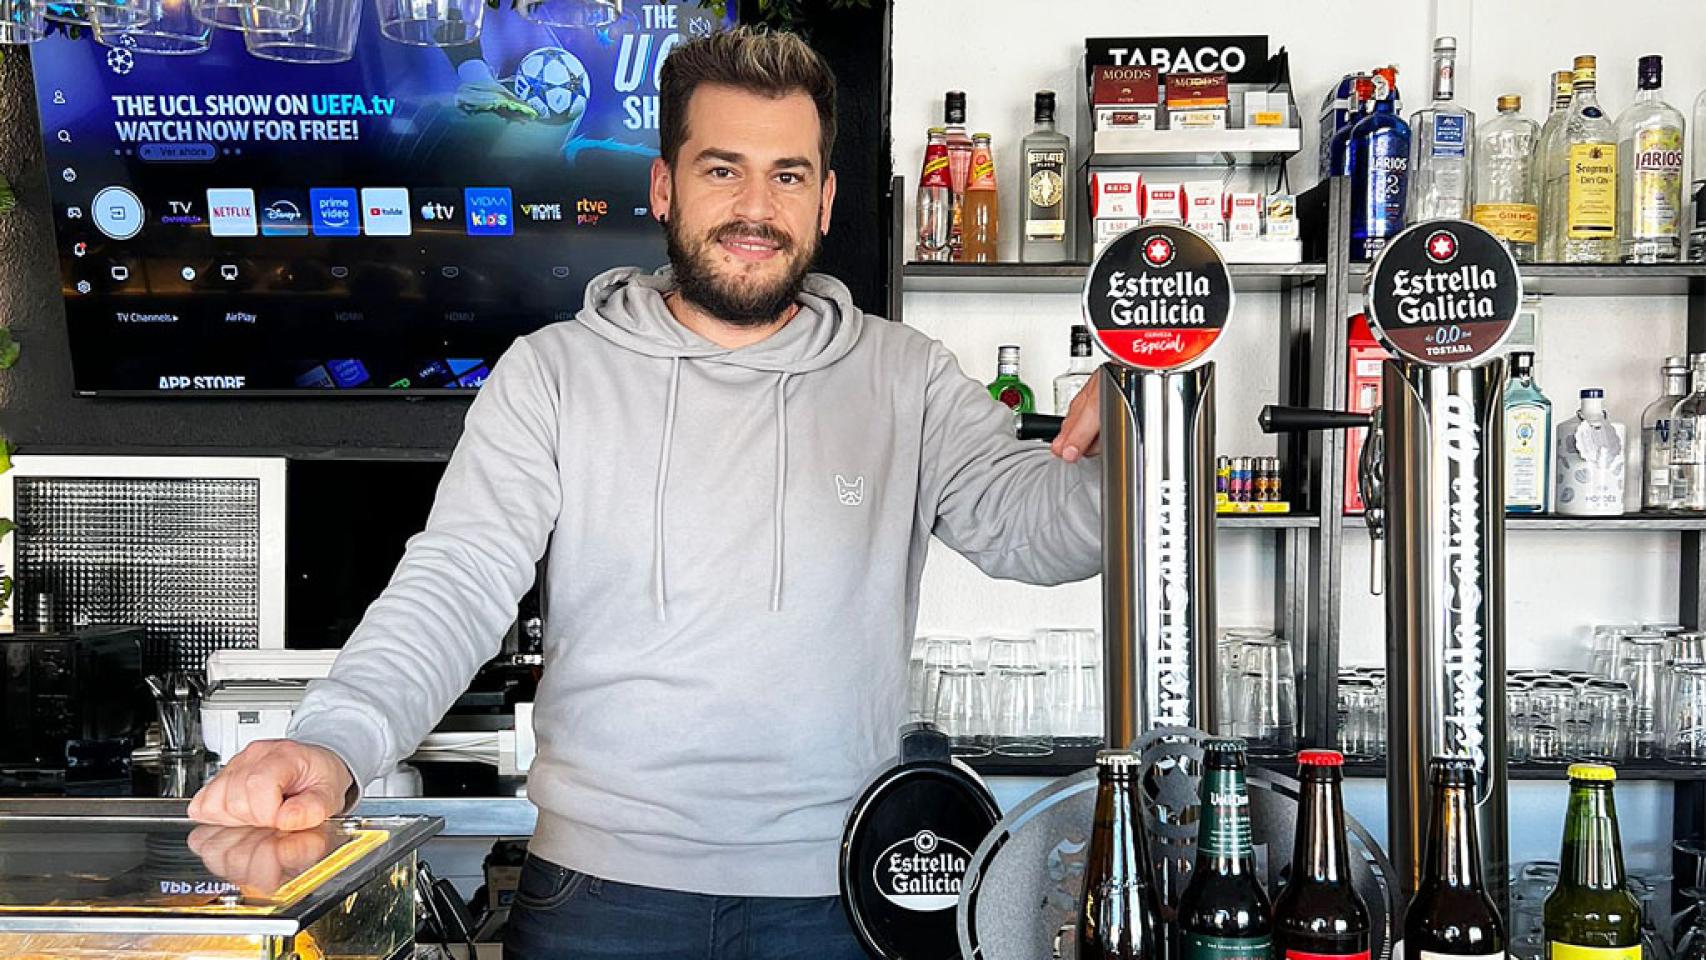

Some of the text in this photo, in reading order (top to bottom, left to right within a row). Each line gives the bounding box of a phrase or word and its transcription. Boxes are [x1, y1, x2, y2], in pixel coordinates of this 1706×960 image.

[642, 5, 678, 29] THE
[614, 34, 679, 92] UC
[1109, 47, 1246, 73] TABACO
[1103, 69, 1151, 80] MOODS
[112, 95, 396, 116] THE UCL SHOW ON UEFA.tv
[623, 97, 661, 130] SH
[115, 121, 359, 141] WATCH NOW FOR FREE!
[1634, 151, 1683, 170] LARIOS
[168, 201, 193, 214] TV
[212, 206, 251, 217] NETFLIX
[319, 198, 349, 208] prime
[434, 202, 454, 220] tv
[576, 198, 608, 215] rtve
[320, 208, 349, 219] video
[471, 210, 508, 226] kids
[577, 214, 599, 226] play
[1106, 271, 1211, 298] Estrella
[1392, 264, 1498, 296] Estrella
[116, 312, 172, 322] TV Channels
[1110, 297, 1206, 326] Galicia
[1397, 291, 1495, 324] Galicia
[225, 312, 257, 324] AirPlay
[1132, 334, 1185, 354] Especial
[1425, 344, 1474, 356] TOSTADA
[159, 376, 245, 389] APP STORE
[888, 852, 966, 872] Estrella
[892, 872, 962, 893] Galicia
